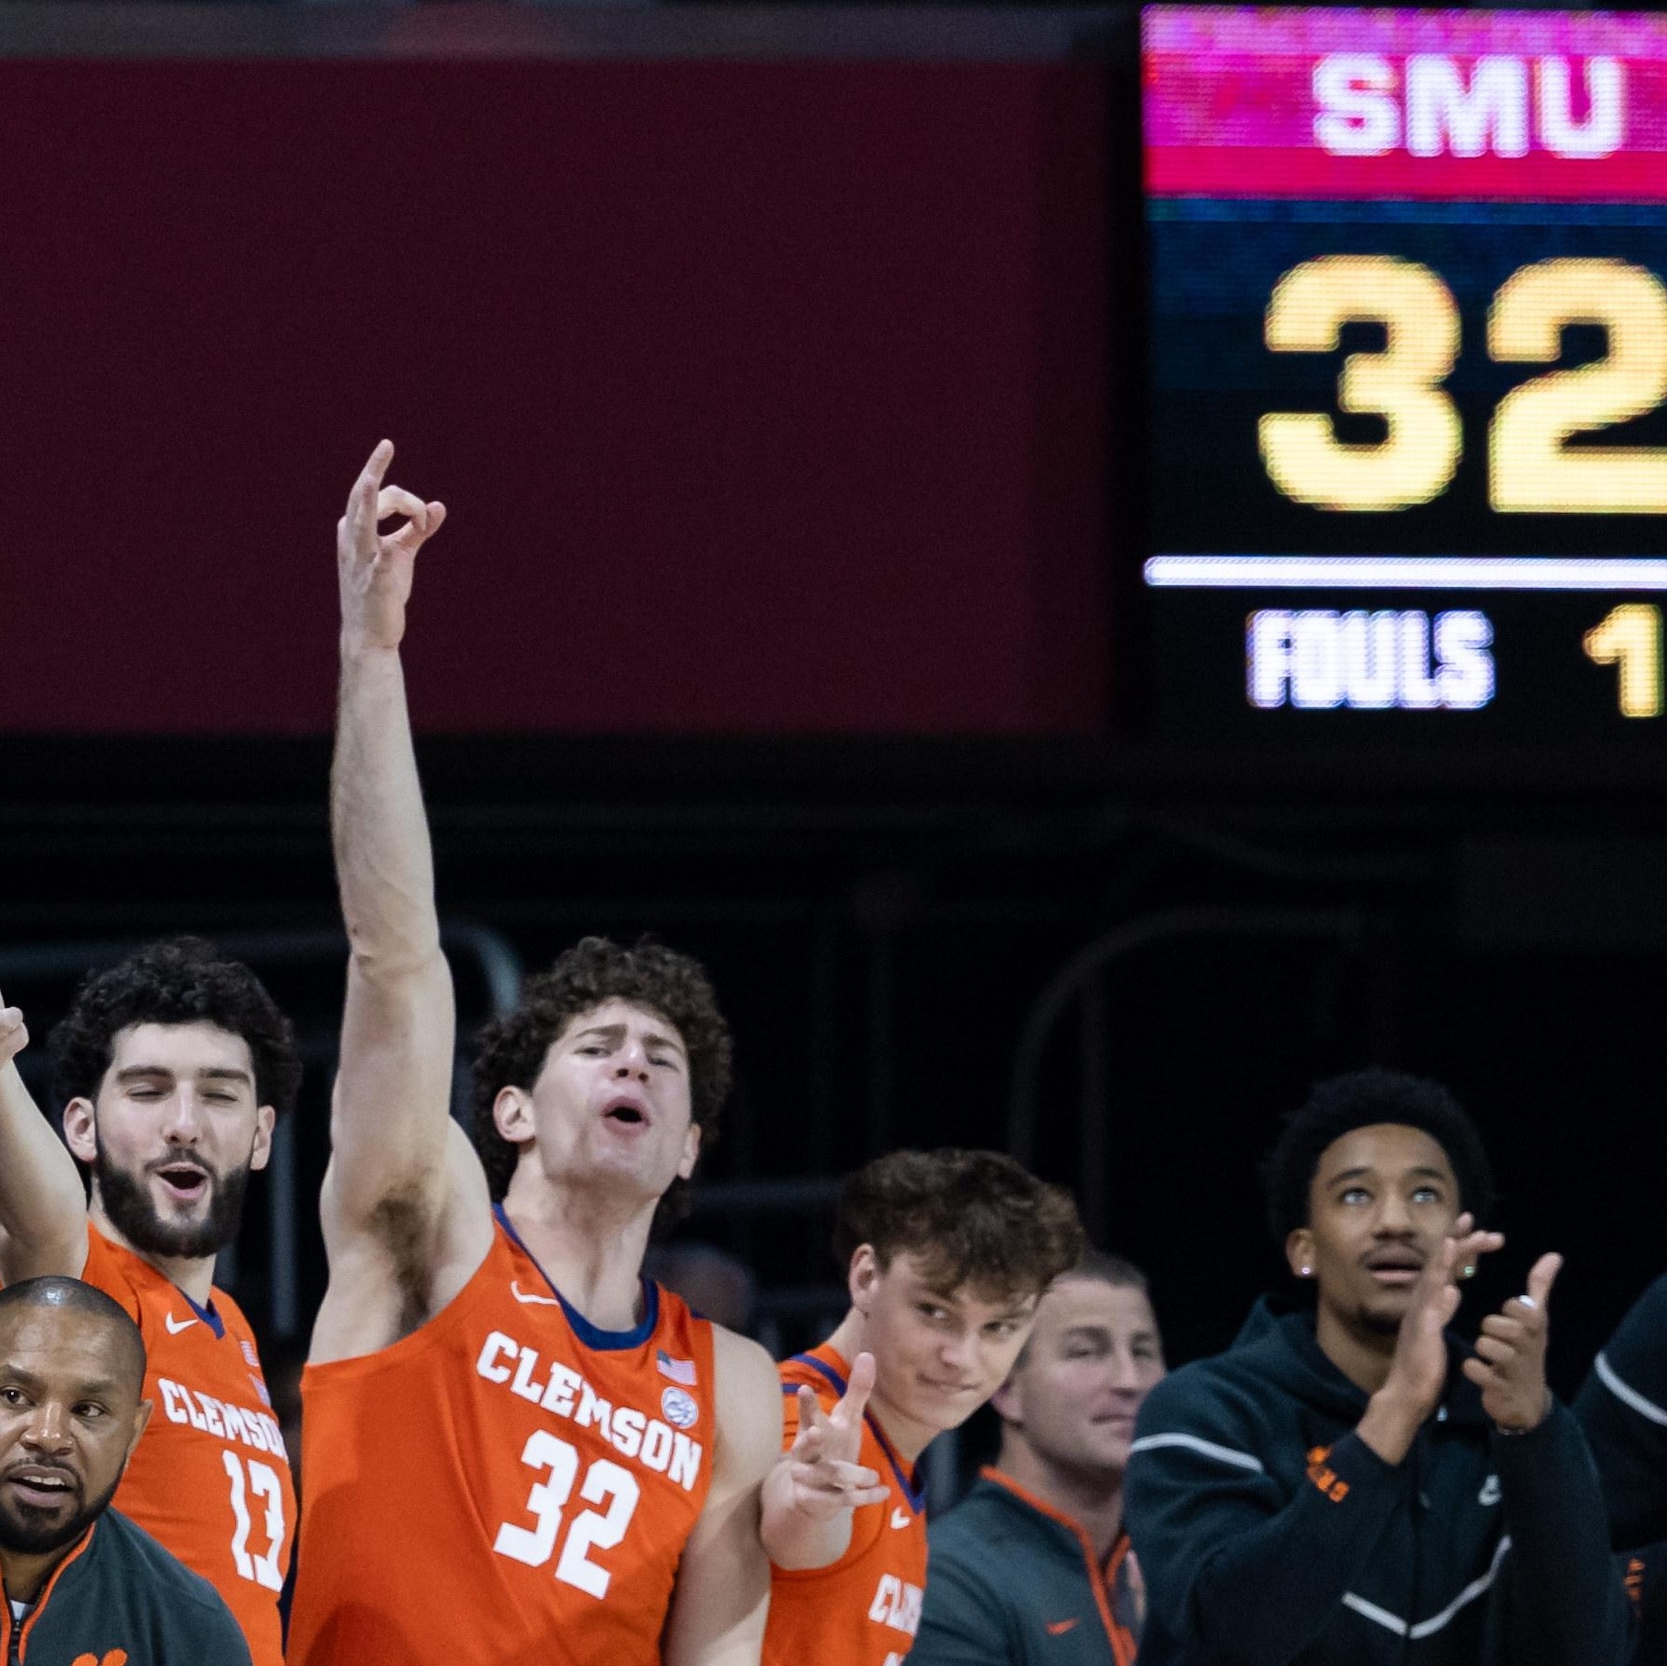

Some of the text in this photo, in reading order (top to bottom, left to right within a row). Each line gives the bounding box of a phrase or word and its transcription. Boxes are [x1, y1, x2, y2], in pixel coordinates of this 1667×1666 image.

[1312, 52, 1626, 159] SMU
[1258, 254, 1667, 513] 32
[1246, 603, 1664, 718] FOULS 1
[157, 1377, 290, 1466] CLEMSO
[476, 1330, 703, 1492] CLEMSON
[221, 1449, 285, 1593] 13
[492, 1428, 641, 1601] 32
